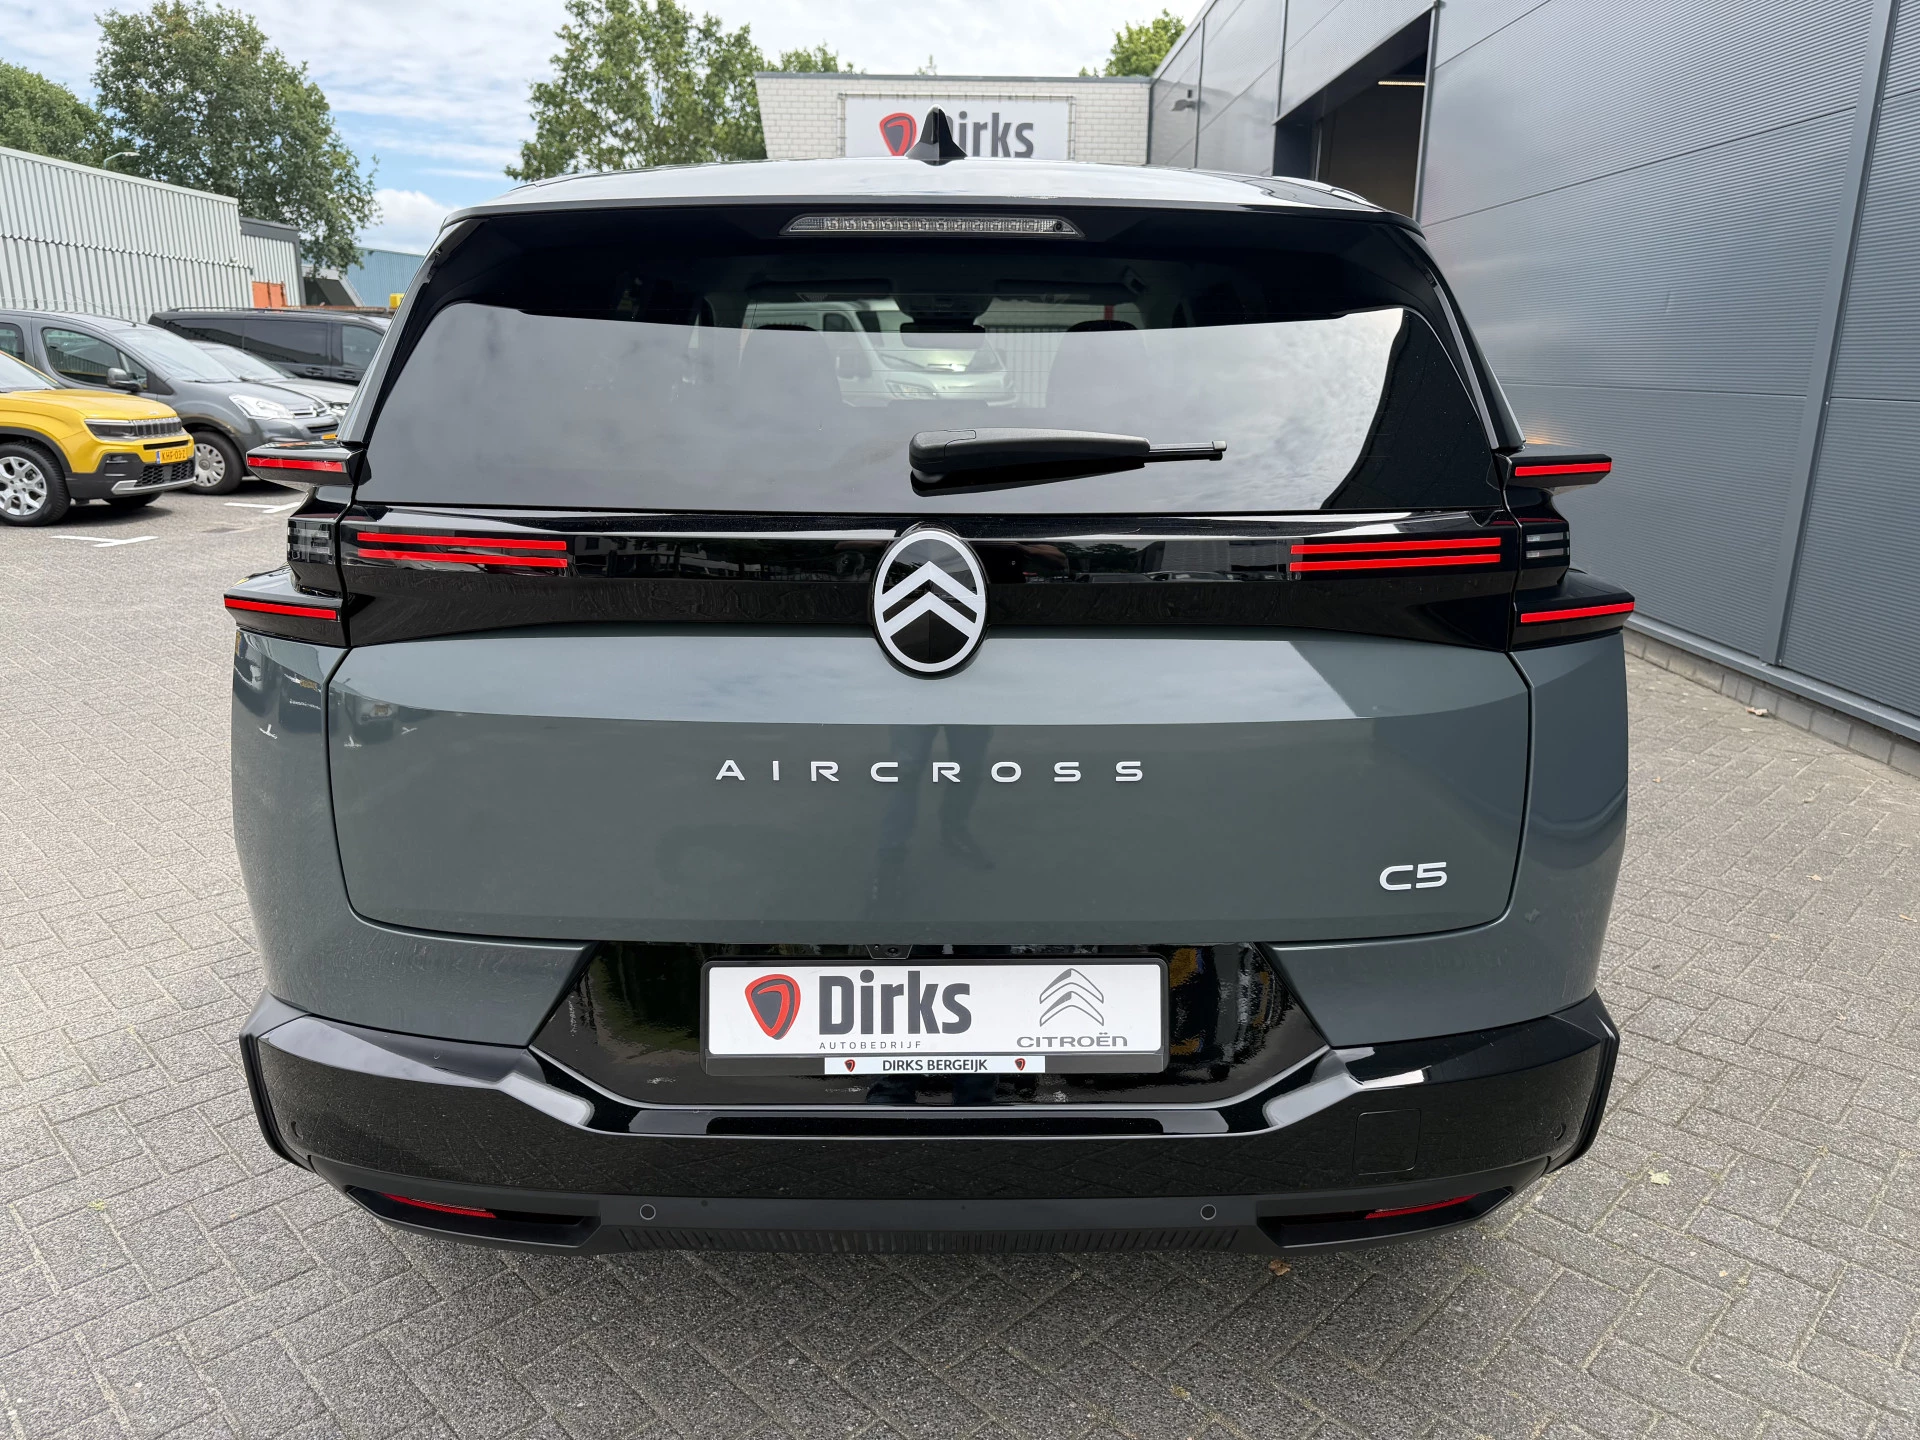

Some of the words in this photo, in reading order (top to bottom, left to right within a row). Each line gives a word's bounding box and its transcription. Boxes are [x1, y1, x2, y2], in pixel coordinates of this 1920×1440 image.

[945, 111, 1034, 158] irks
[715, 759, 1143, 783] AIRCROSS
[1379, 862, 1448, 891] C5
[818, 969, 972, 1035] Dirks
[819, 1040, 922, 1050] AUTOBEDRIJF
[882, 1059, 923, 1072] DIRKS
[927, 1059, 988, 1073] BERGEIJK
